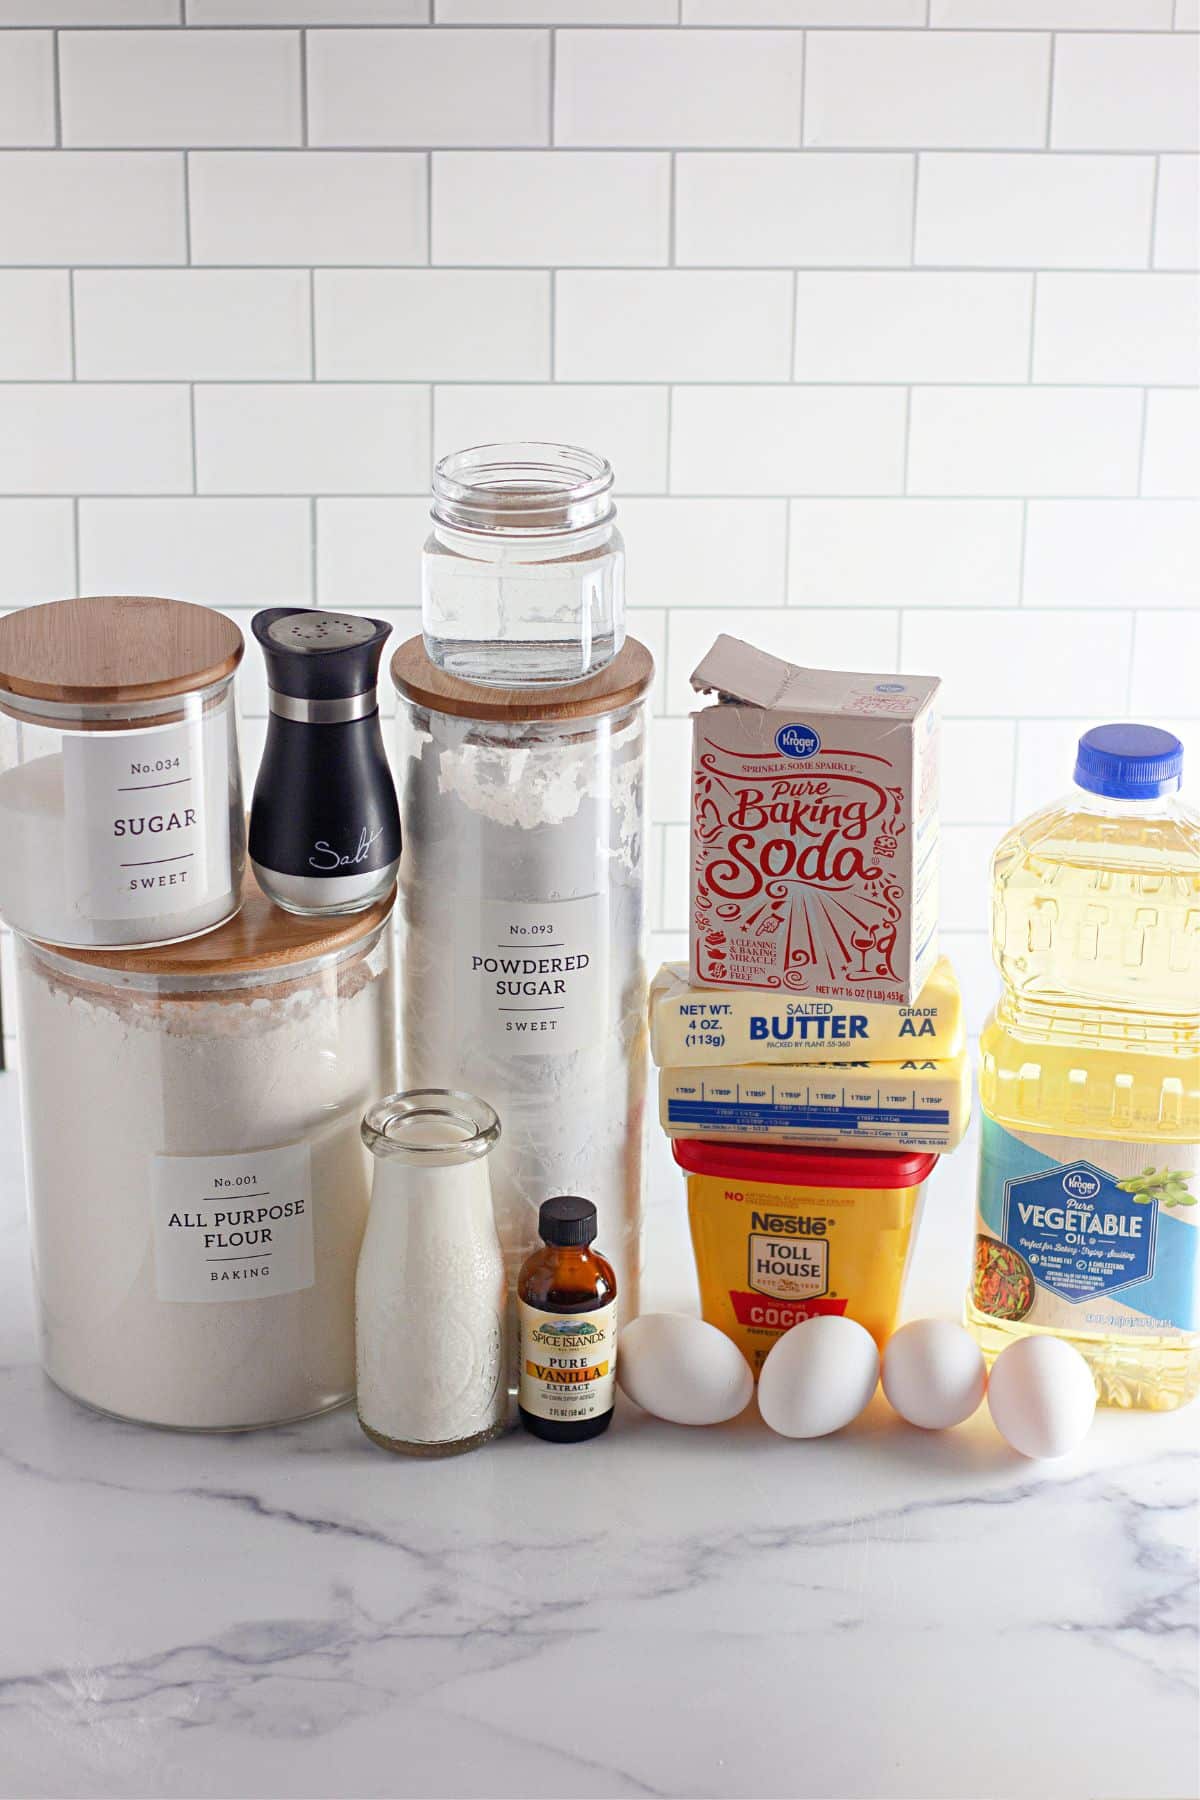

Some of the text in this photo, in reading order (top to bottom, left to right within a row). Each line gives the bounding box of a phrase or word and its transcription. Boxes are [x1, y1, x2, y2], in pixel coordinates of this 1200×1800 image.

[782, 729, 815, 754] Kroger
[131, 757, 181, 775] No.034
[741, 763, 787, 774] SPRINKLE
[788, 762, 813, 770] SOME
[771, 780, 831, 801] Pure
[728, 788, 868, 840] Baking
[113, 808, 198, 836] SUGAR
[308, 826, 384, 870] Salt
[705, 829, 883, 900] Soda
[130, 871, 188, 890] SWEET
[510, 925, 554, 935] No.093
[735, 939, 777, 950] CLEANING
[739, 946, 777, 957] BAKING
[472, 954, 590, 975] POWDERED
[729, 953, 777, 966] MIRACLE
[729, 964, 766, 975] GLUTEN
[729, 972, 753, 981] FREE
[496, 979, 567, 996] SUGAR
[815, 985, 829, 994] NET
[831, 986, 844, 996] WT
[845, 987, 852, 997] 16
[854, 988, 865, 998] OZ
[679, 1004, 733, 1015] NET WT.
[786, 1003, 833, 1016] SALTED
[898, 1008, 938, 1017] GRADE
[505, 1020, 558, 1031] SWEET
[688, 1019, 723, 1030] 4 OZ.
[749, 1015, 870, 1040] BUTTER
[897, 1018, 936, 1038] AA
[685, 1034, 725, 1047] (113g)
[767, 1041, 793, 1049] PACKED
[214, 1175, 258, 1188] No.001
[1068, 1174, 1096, 1195] Kroger
[724, 1191, 744, 1202] NO
[1065, 1198, 1096, 1212] Pure
[168, 1199, 305, 1227] ALL PURPOSE
[1017, 1202, 1143, 1238] VEGETABLE
[204, 1228, 273, 1248] FLOUR
[1065, 1232, 1087, 1245] OIL
[766, 1243, 812, 1261] TOLL
[210, 1266, 270, 1281] BAKING
[756, 1258, 821, 1278] HOUSE
[750, 1306, 820, 1327] COCO
[532, 1329, 604, 1347] SPICE ISLANDS
[549, 1357, 588, 1369] PURE
[535, 1365, 602, 1384] VANILLA
[546, 1383, 591, 1392] EXTRACT
